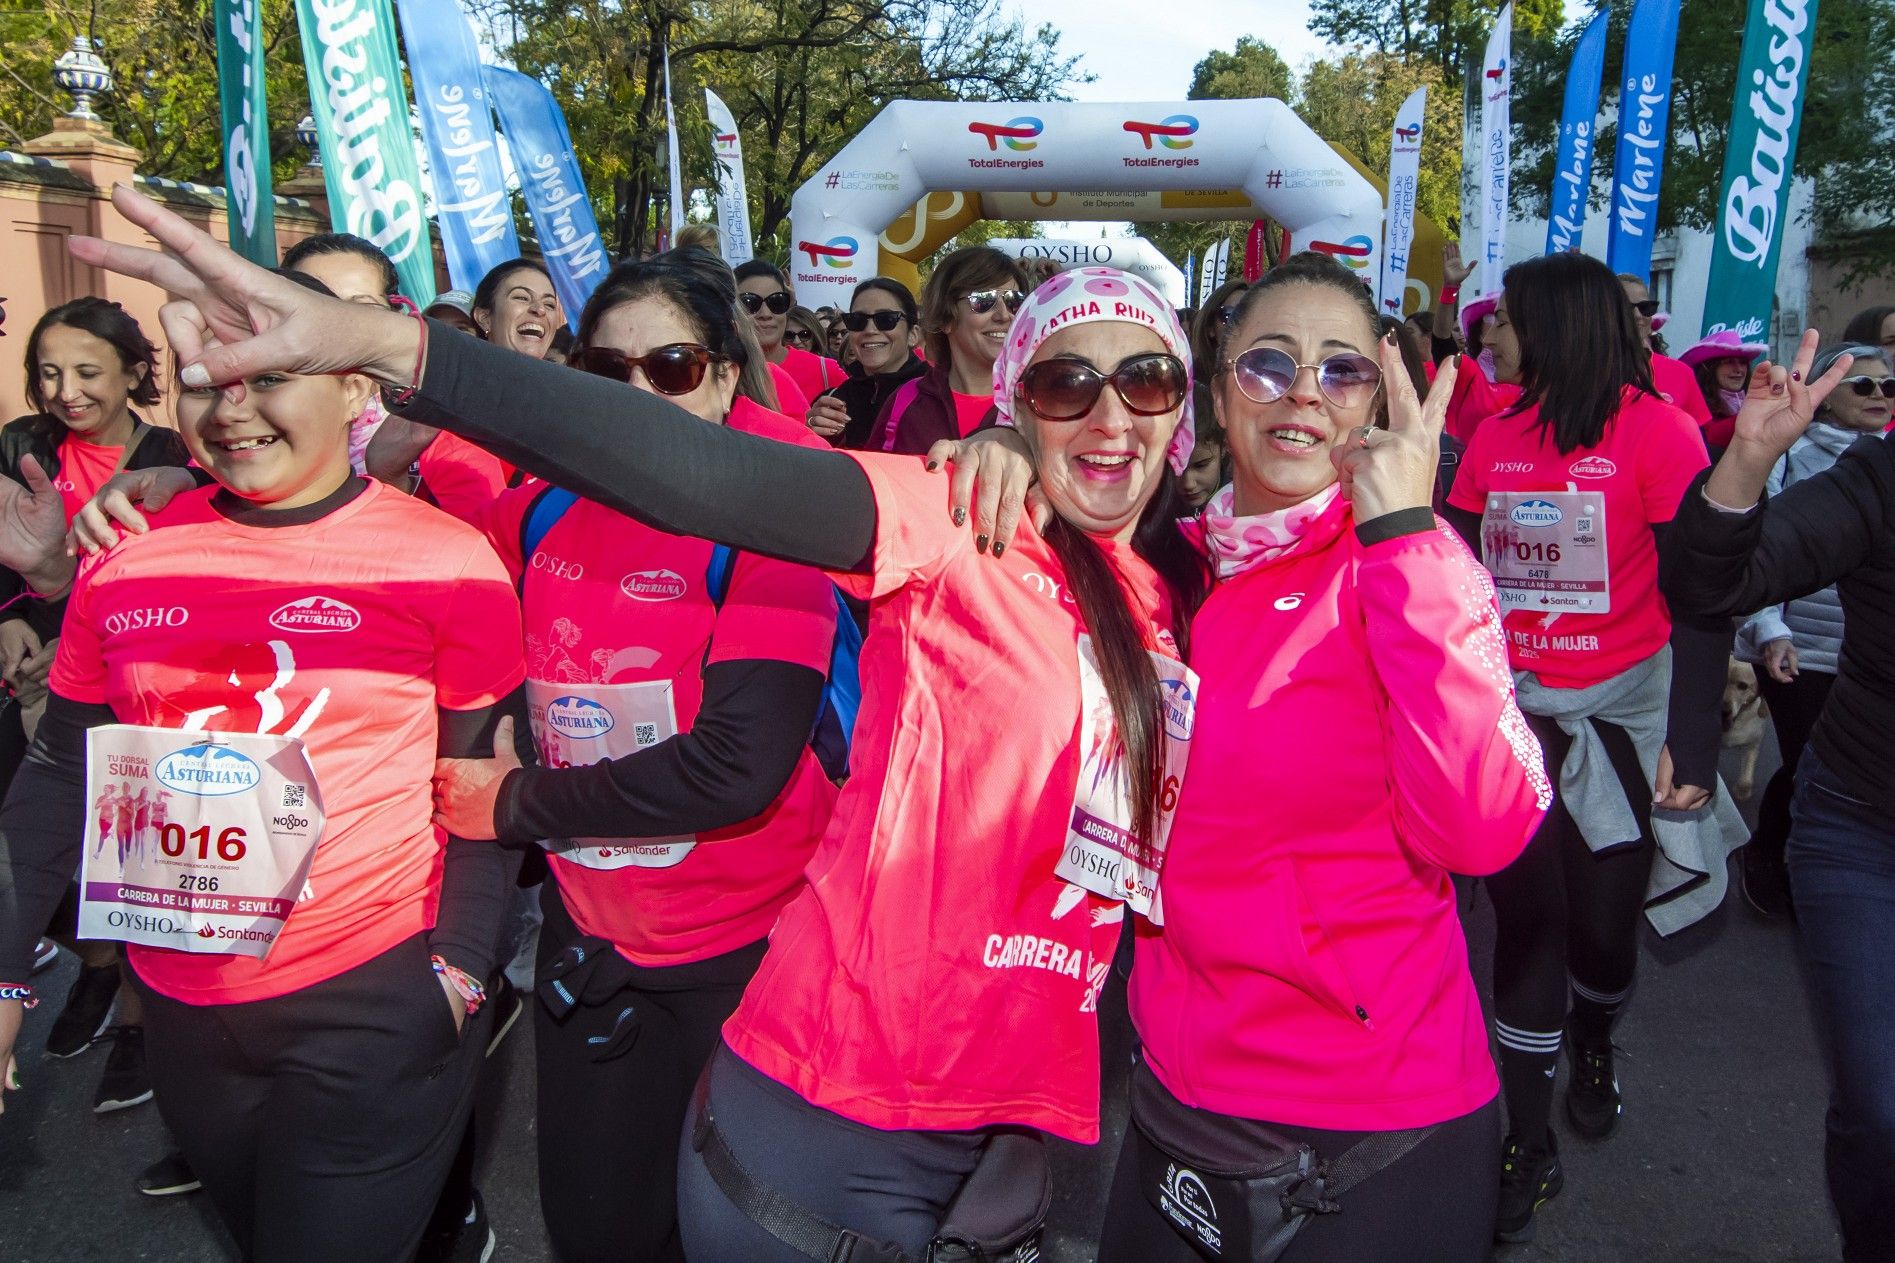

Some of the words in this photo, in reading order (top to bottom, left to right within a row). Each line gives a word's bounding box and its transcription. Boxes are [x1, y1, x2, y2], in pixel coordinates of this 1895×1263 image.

[1725, 0, 1808, 270] Batist
[969, 159, 1043, 169] TotalEnergies
[1123, 158, 1199, 168] TotalEnergies
[1618, 74, 1664, 237] Marlene
[1096, 200, 1134, 208] Deportes
[1020, 245, 1112, 263] OYSHO
[1139, 263, 1168, 272] OYSHO
[798, 274, 857, 284] TotalEnergies
[1516, 542, 1561, 562] 016
[532, 552, 584, 580] OSHO
[1528, 570, 1549, 579] 6478
[1022, 572, 1075, 603] OYS
[1500, 592, 1526, 603] YSHO
[1550, 597, 1592, 605] Santanr
[106, 607, 189, 634] OYSHO
[275, 611, 353, 627] ASTURIANA
[1514, 632, 1529, 646] DE
[1533, 635, 1548, 649] LA
[1552, 636, 1599, 651] MUJER
[551, 709, 610, 728] ASTURIANA
[107, 754, 118, 762] TU
[121, 755, 149, 765] DORSAL
[109, 763, 149, 779] SUMA
[162, 761, 253, 784] ASTURIANA
[161, 823, 247, 861] 016
[614, 844, 671, 857] Santander
[179, 874, 218, 891] 2786
[117, 887, 159, 904] CARRERA
[163, 893, 175, 905] DE
[178, 896, 189, 908] LA
[191, 898, 228, 911] MUJER
[238, 901, 281, 913] SEVILLA
[108, 911, 173, 934] OYSHO
[983, 933, 1082, 980] CARRERA
